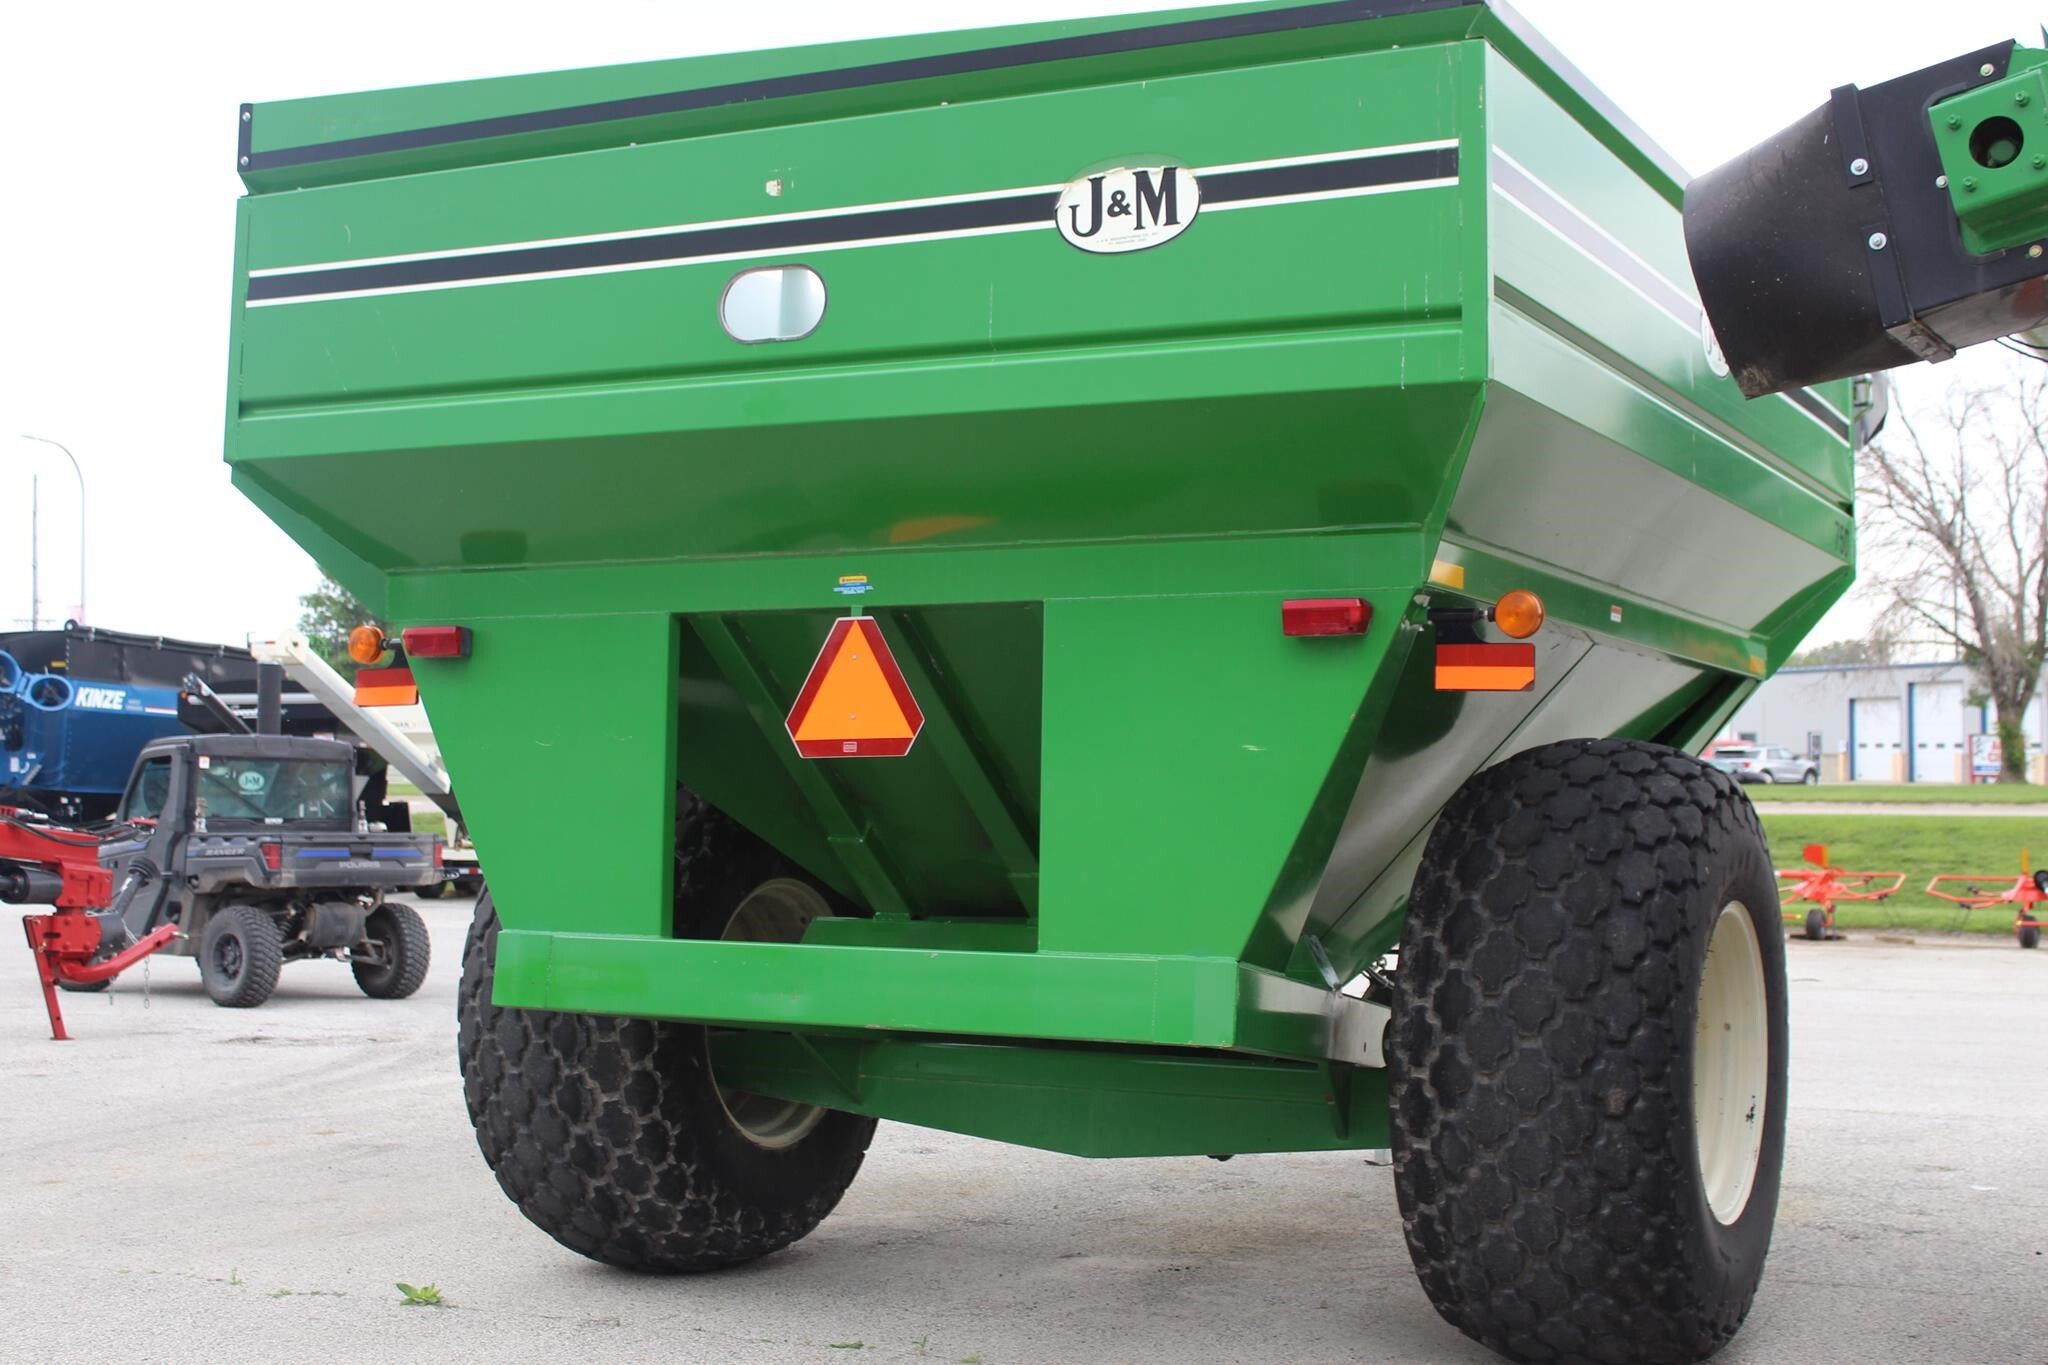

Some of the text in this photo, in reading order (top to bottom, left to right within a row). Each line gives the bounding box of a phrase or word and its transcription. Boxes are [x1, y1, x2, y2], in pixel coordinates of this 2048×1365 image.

[1069, 166, 1181, 238] J&M
[75, 686, 126, 710] KINZE
[205, 847, 246, 856] RANGER
[338, 860, 381, 869] POLARIS
